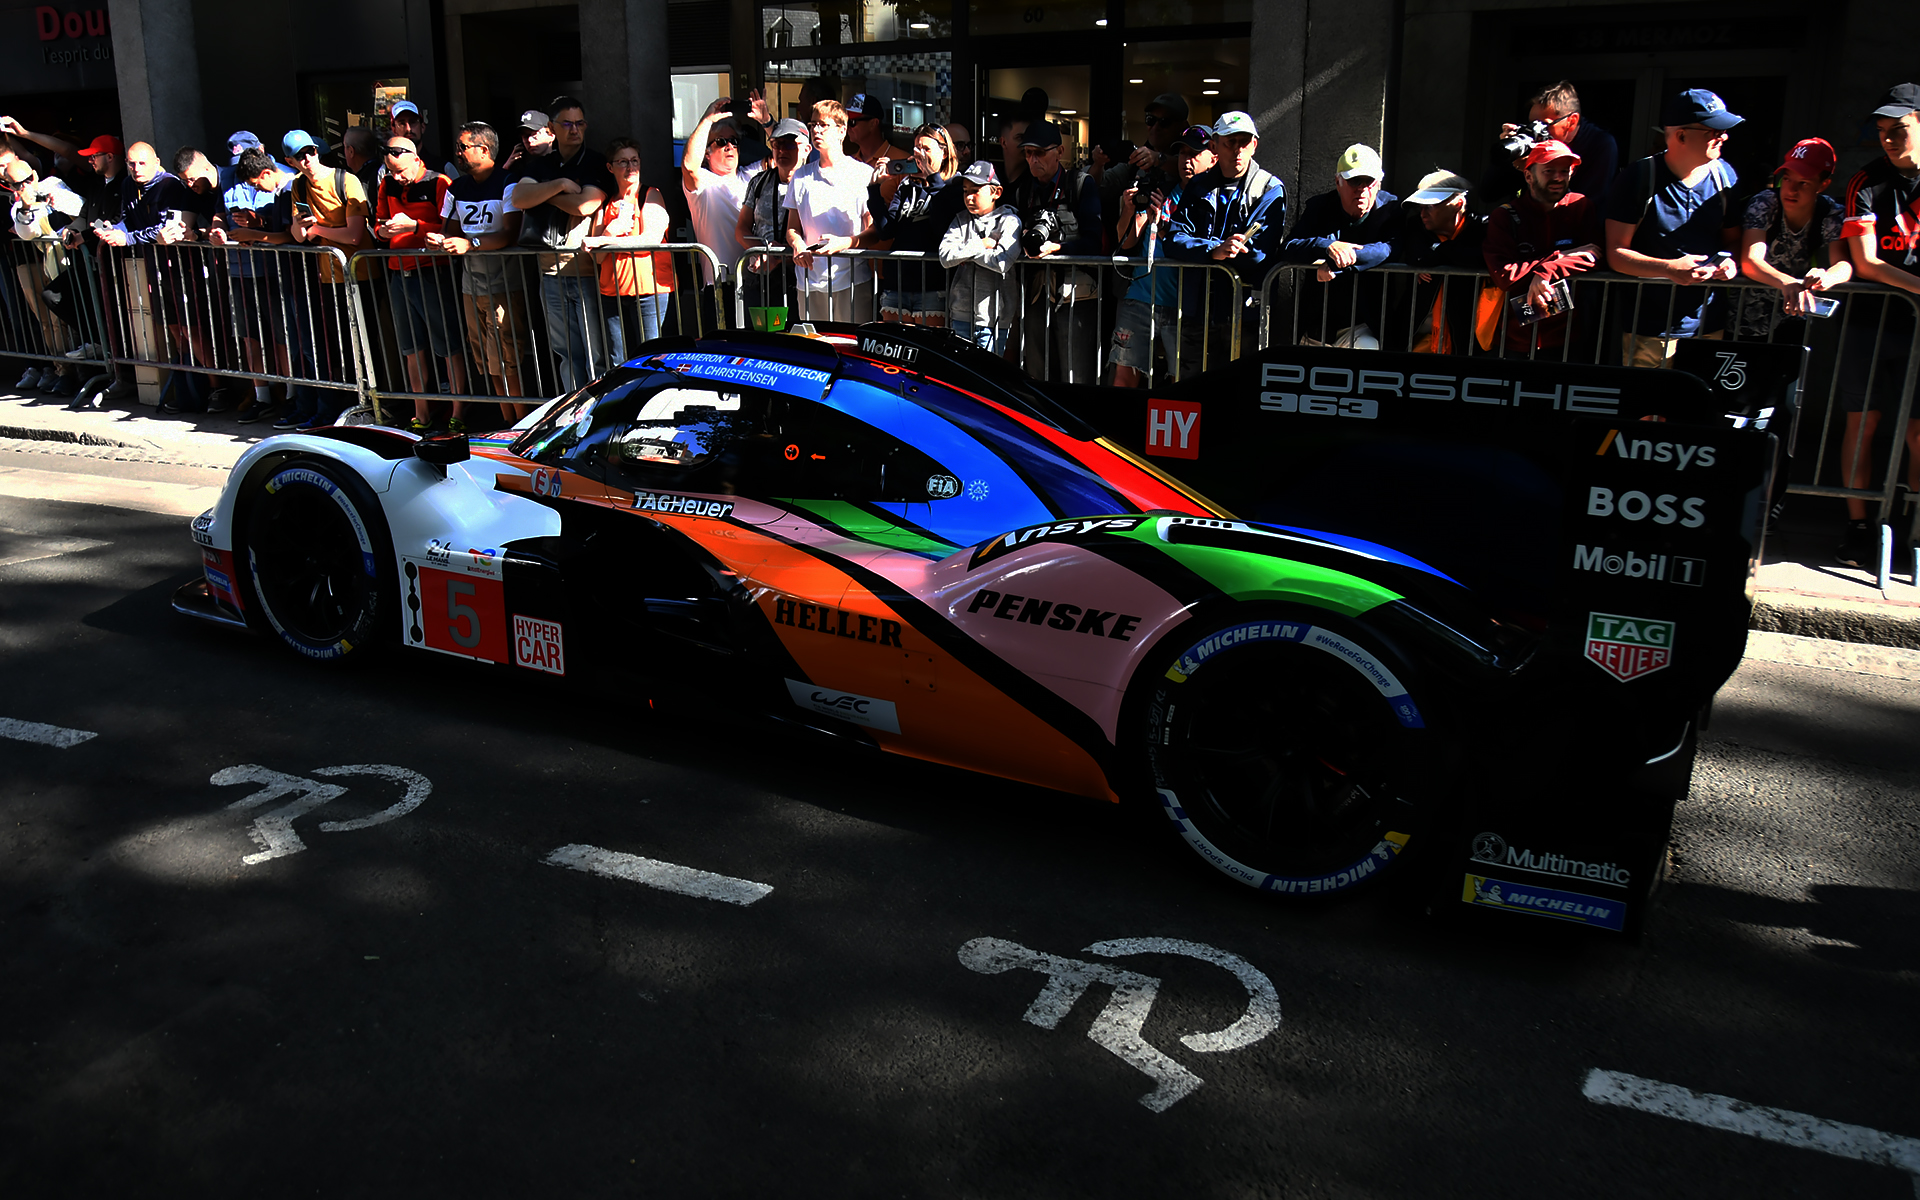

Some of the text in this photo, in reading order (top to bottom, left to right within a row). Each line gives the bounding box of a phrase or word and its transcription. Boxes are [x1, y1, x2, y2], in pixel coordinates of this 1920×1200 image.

[36, 5, 110, 41] Dou
[1023, 7, 1044, 23] 60
[1576, 24, 1733, 48] 58 MERMOZ
[42, 43, 110, 67] l'esprit du
[862, 338, 903, 359] Mobil
[666, 353, 676, 361] D.
[677, 353, 725, 364] CAMERON
[754, 359, 828, 382] MAKOWIECKI
[691, 365, 778, 387] M. CHRISTENSEN
[1713, 352, 1748, 390] 75
[1260, 362, 1622, 415] PORSCHE
[1260, 391, 1379, 419] 963
[1148, 408, 1198, 450] HY
[1595, 428, 1717, 471] Ansys
[281, 471, 332, 492] MICHELIN
[1586, 486, 1706, 528] BOSS
[976, 519, 1137, 559] Ansys
[1573, 544, 1667, 581] Mobil
[446, 579, 481, 648] 5
[516, 618, 560, 643] HYPER
[775, 598, 902, 648] HELLER
[967, 589, 1142, 642] PENSKE
[1596, 616, 1666, 644] TAG
[284, 634, 334, 658] MICHELIN
[517, 636, 562, 671] CAR
[1196, 624, 1299, 661] MICHELIN
[1590, 643, 1666, 677] HEUER
[1315, 634, 1391, 689] #WeRaceForChange
[810, 692, 870, 714] WEC
[1192, 838, 1254, 881] PILOT SPORT
[1270, 857, 1377, 893] MICHELIN
[1506, 846, 1631, 884] Multimatic
[1508, 893, 1611, 919] MICHELIN
